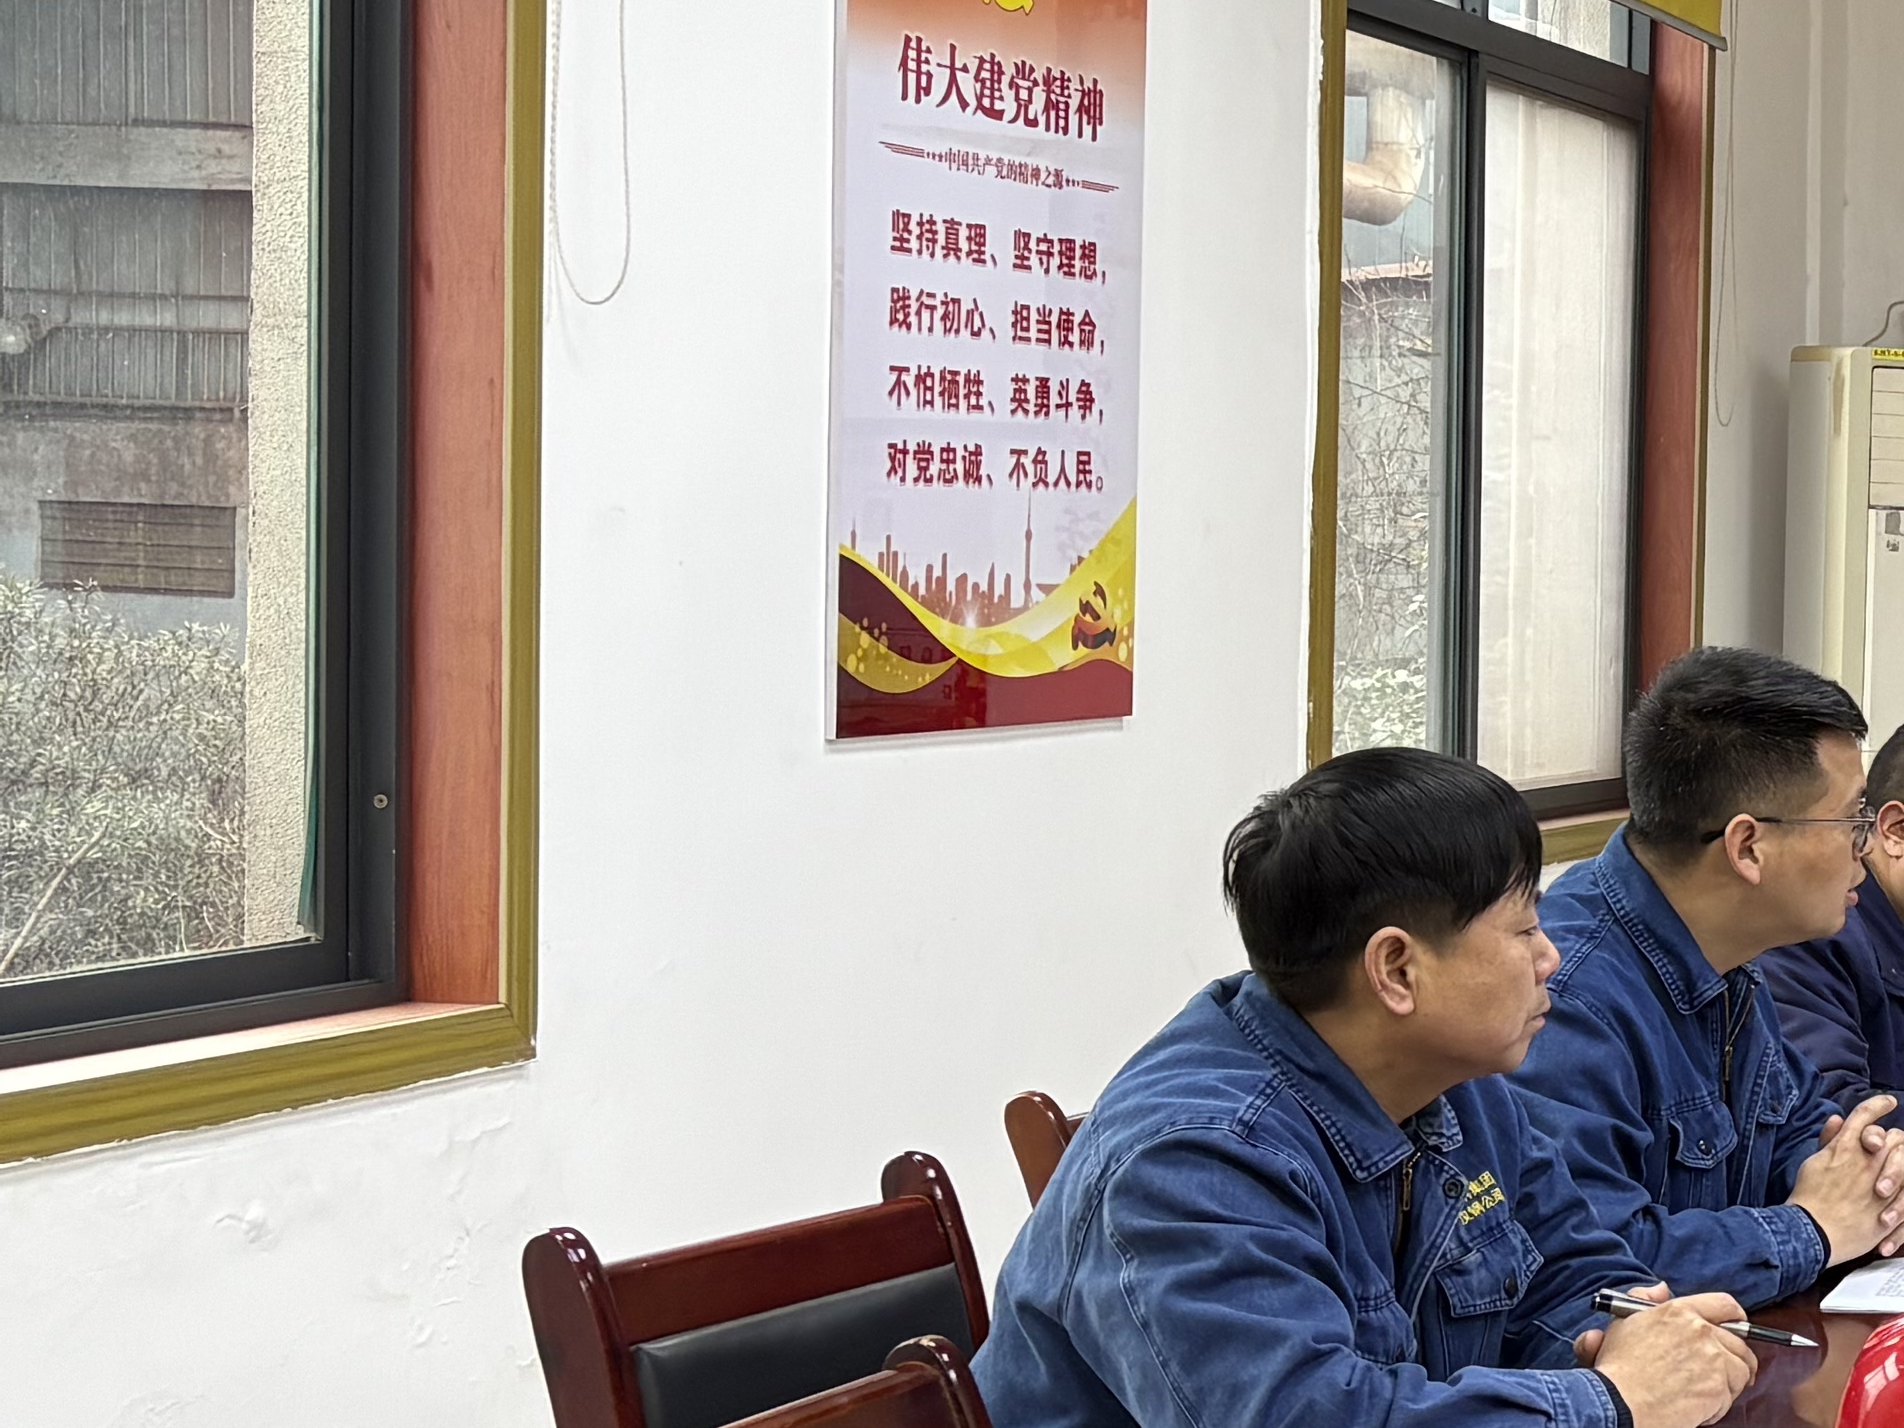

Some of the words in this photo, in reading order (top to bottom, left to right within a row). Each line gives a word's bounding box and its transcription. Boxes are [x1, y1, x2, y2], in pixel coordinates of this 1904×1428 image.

[898, 33, 1104, 143] 伟大建党精神
[890, 209, 1106, 285] 坚持真理、坚守理想，
[888, 286, 1104, 355] 践行初心、担当使命，
[887, 364, 1103, 425] 不怕牺牲、英勇斗争，
[886, 439, 1104, 494] 对党忠诚、不负人民。
